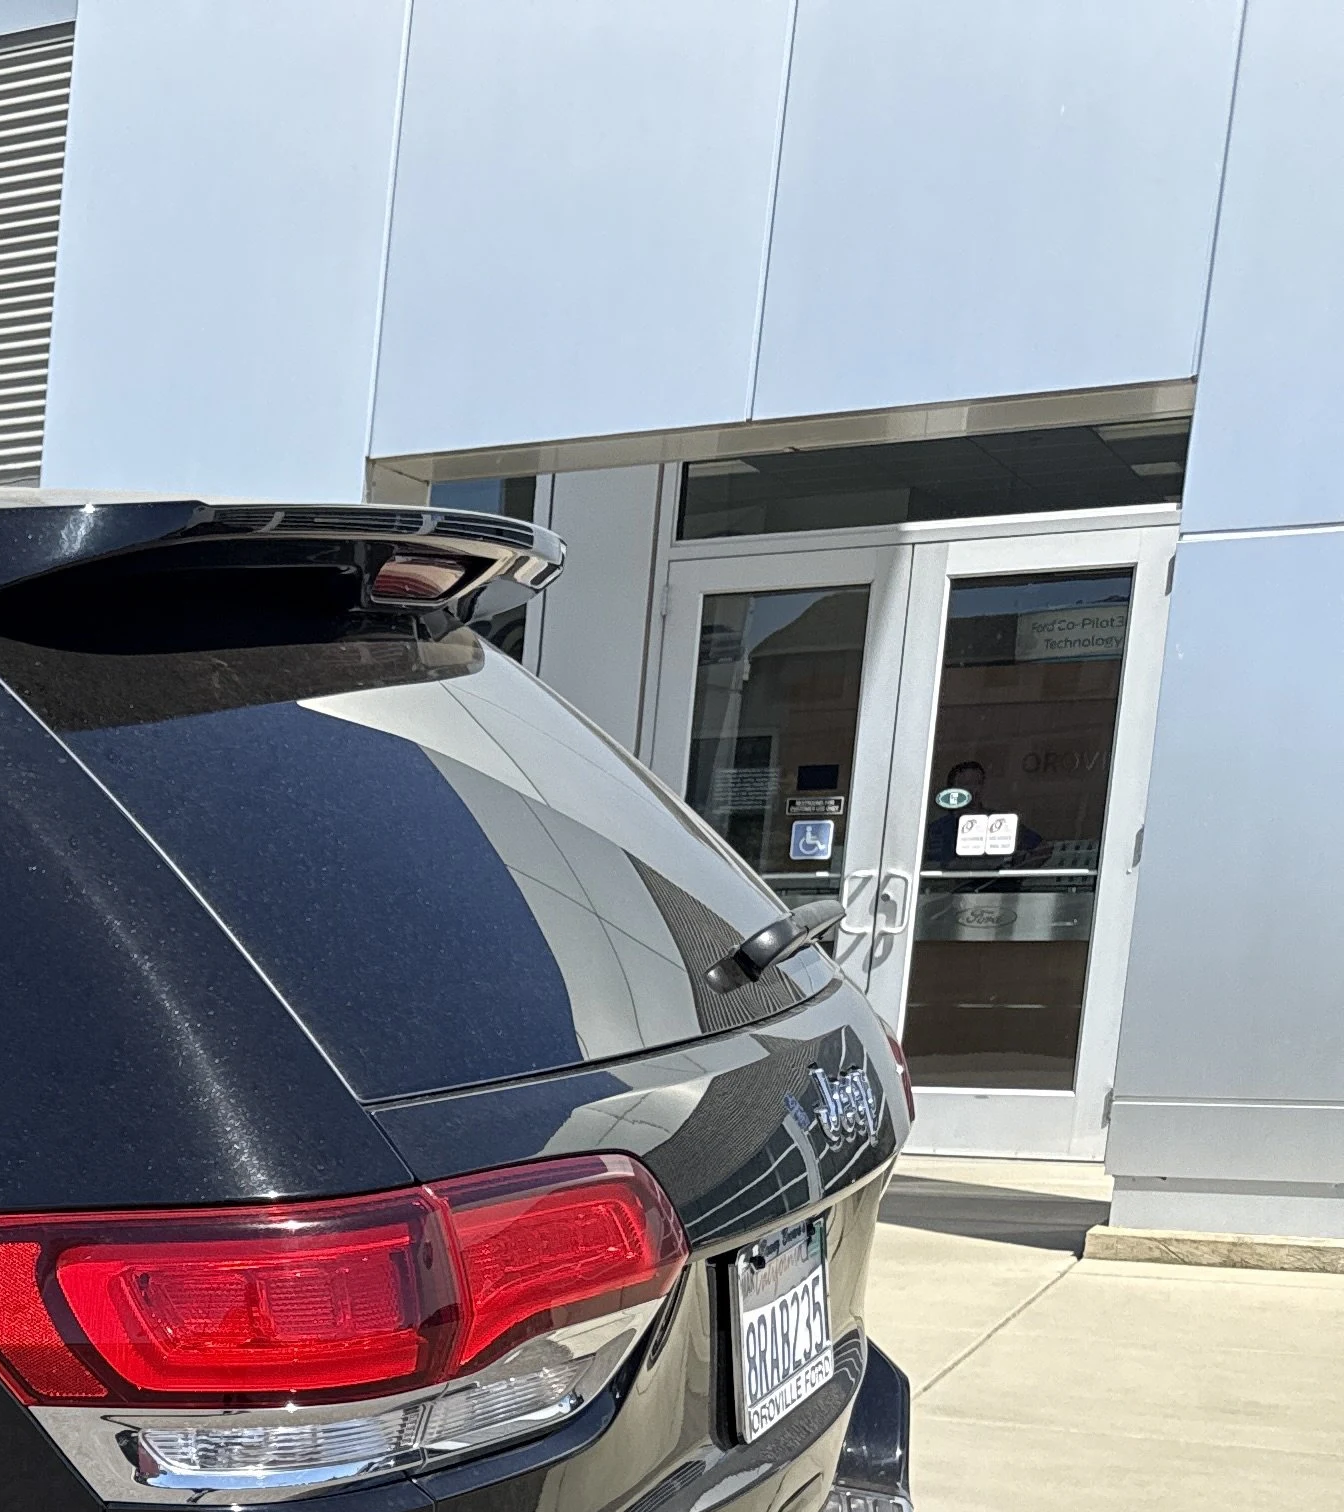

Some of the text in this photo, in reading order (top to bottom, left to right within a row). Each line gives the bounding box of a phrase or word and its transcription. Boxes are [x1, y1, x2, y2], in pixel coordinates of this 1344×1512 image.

[1031, 620, 1055, 633] Ford
[1044, 635, 1124, 650] Technology
[808, 1068, 878, 1147] Jeep
[746, 1274, 825, 1404] 8RAB235
[752, 1356, 831, 1434] OROVILLE FORD
